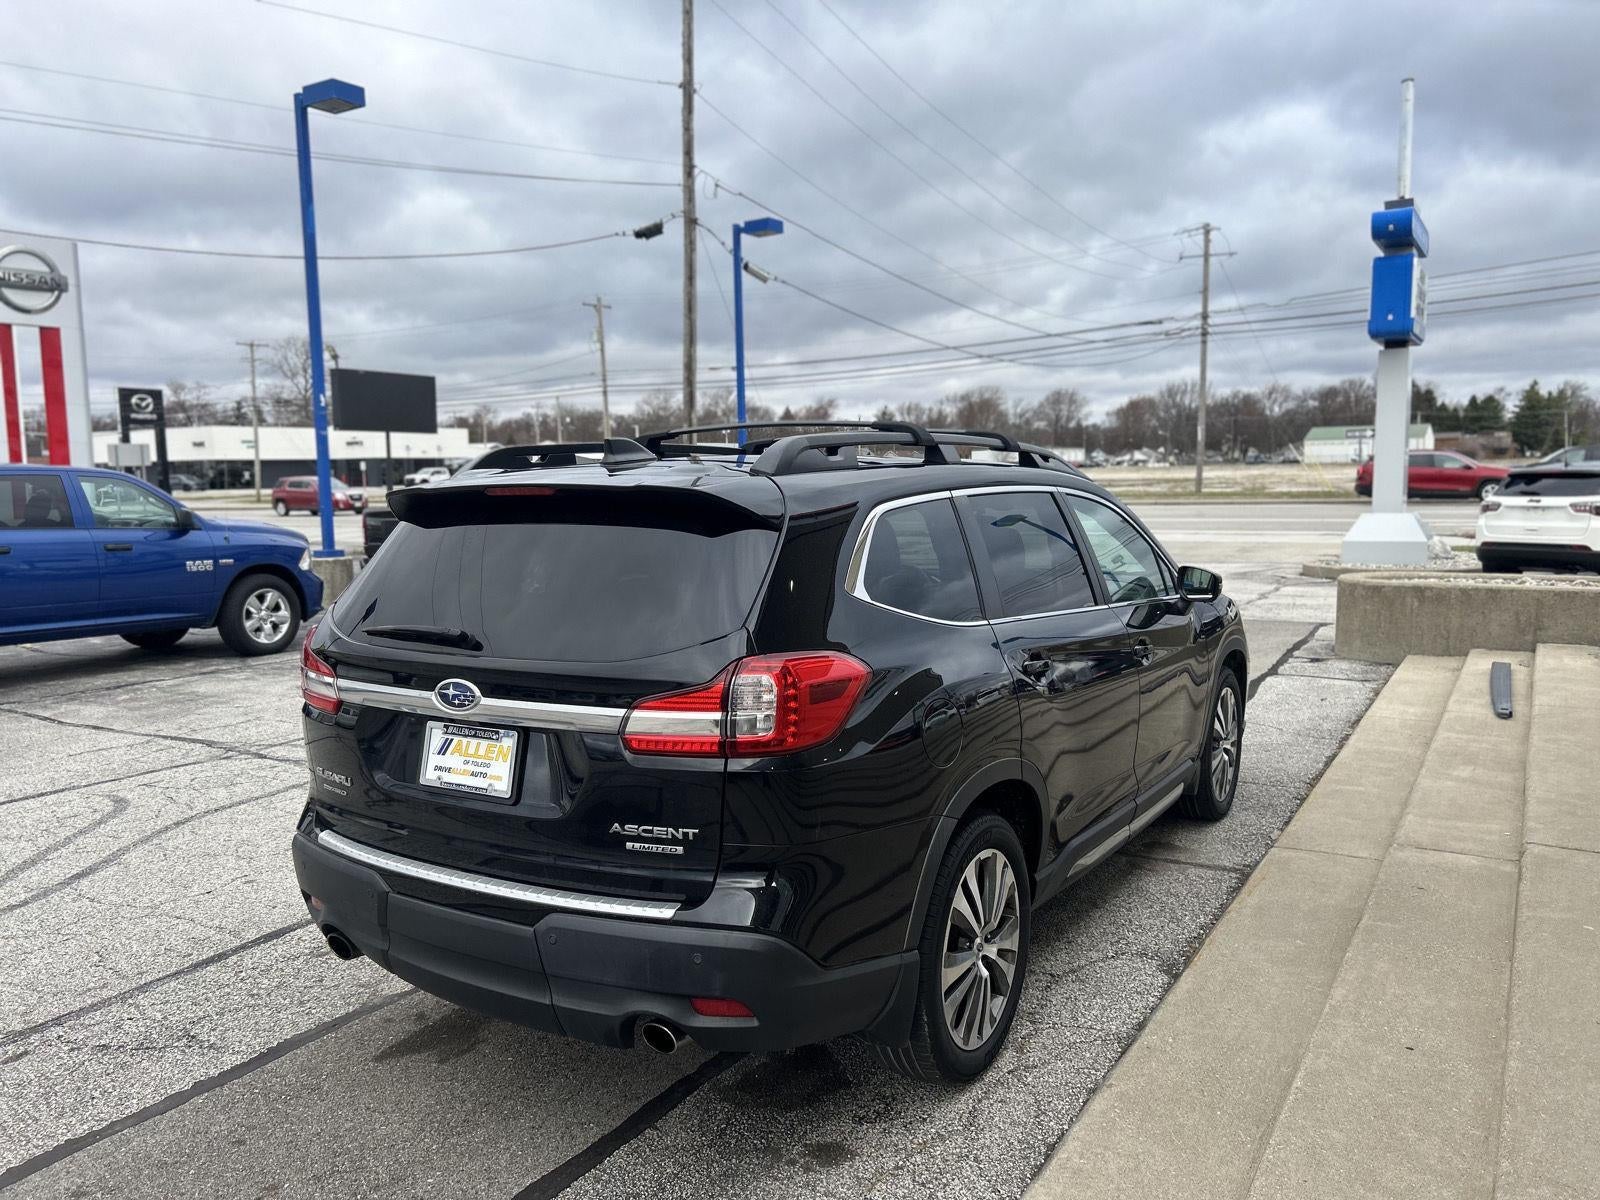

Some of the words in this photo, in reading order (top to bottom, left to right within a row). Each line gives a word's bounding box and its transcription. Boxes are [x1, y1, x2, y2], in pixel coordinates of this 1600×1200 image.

[452, 725, 470, 736] ALLEN
[450, 739, 511, 763] ALLEN
[471, 760, 491, 769] TOLEDO
[608, 822, 699, 840] ASCENT
[631, 843, 678, 853] LIMITED
